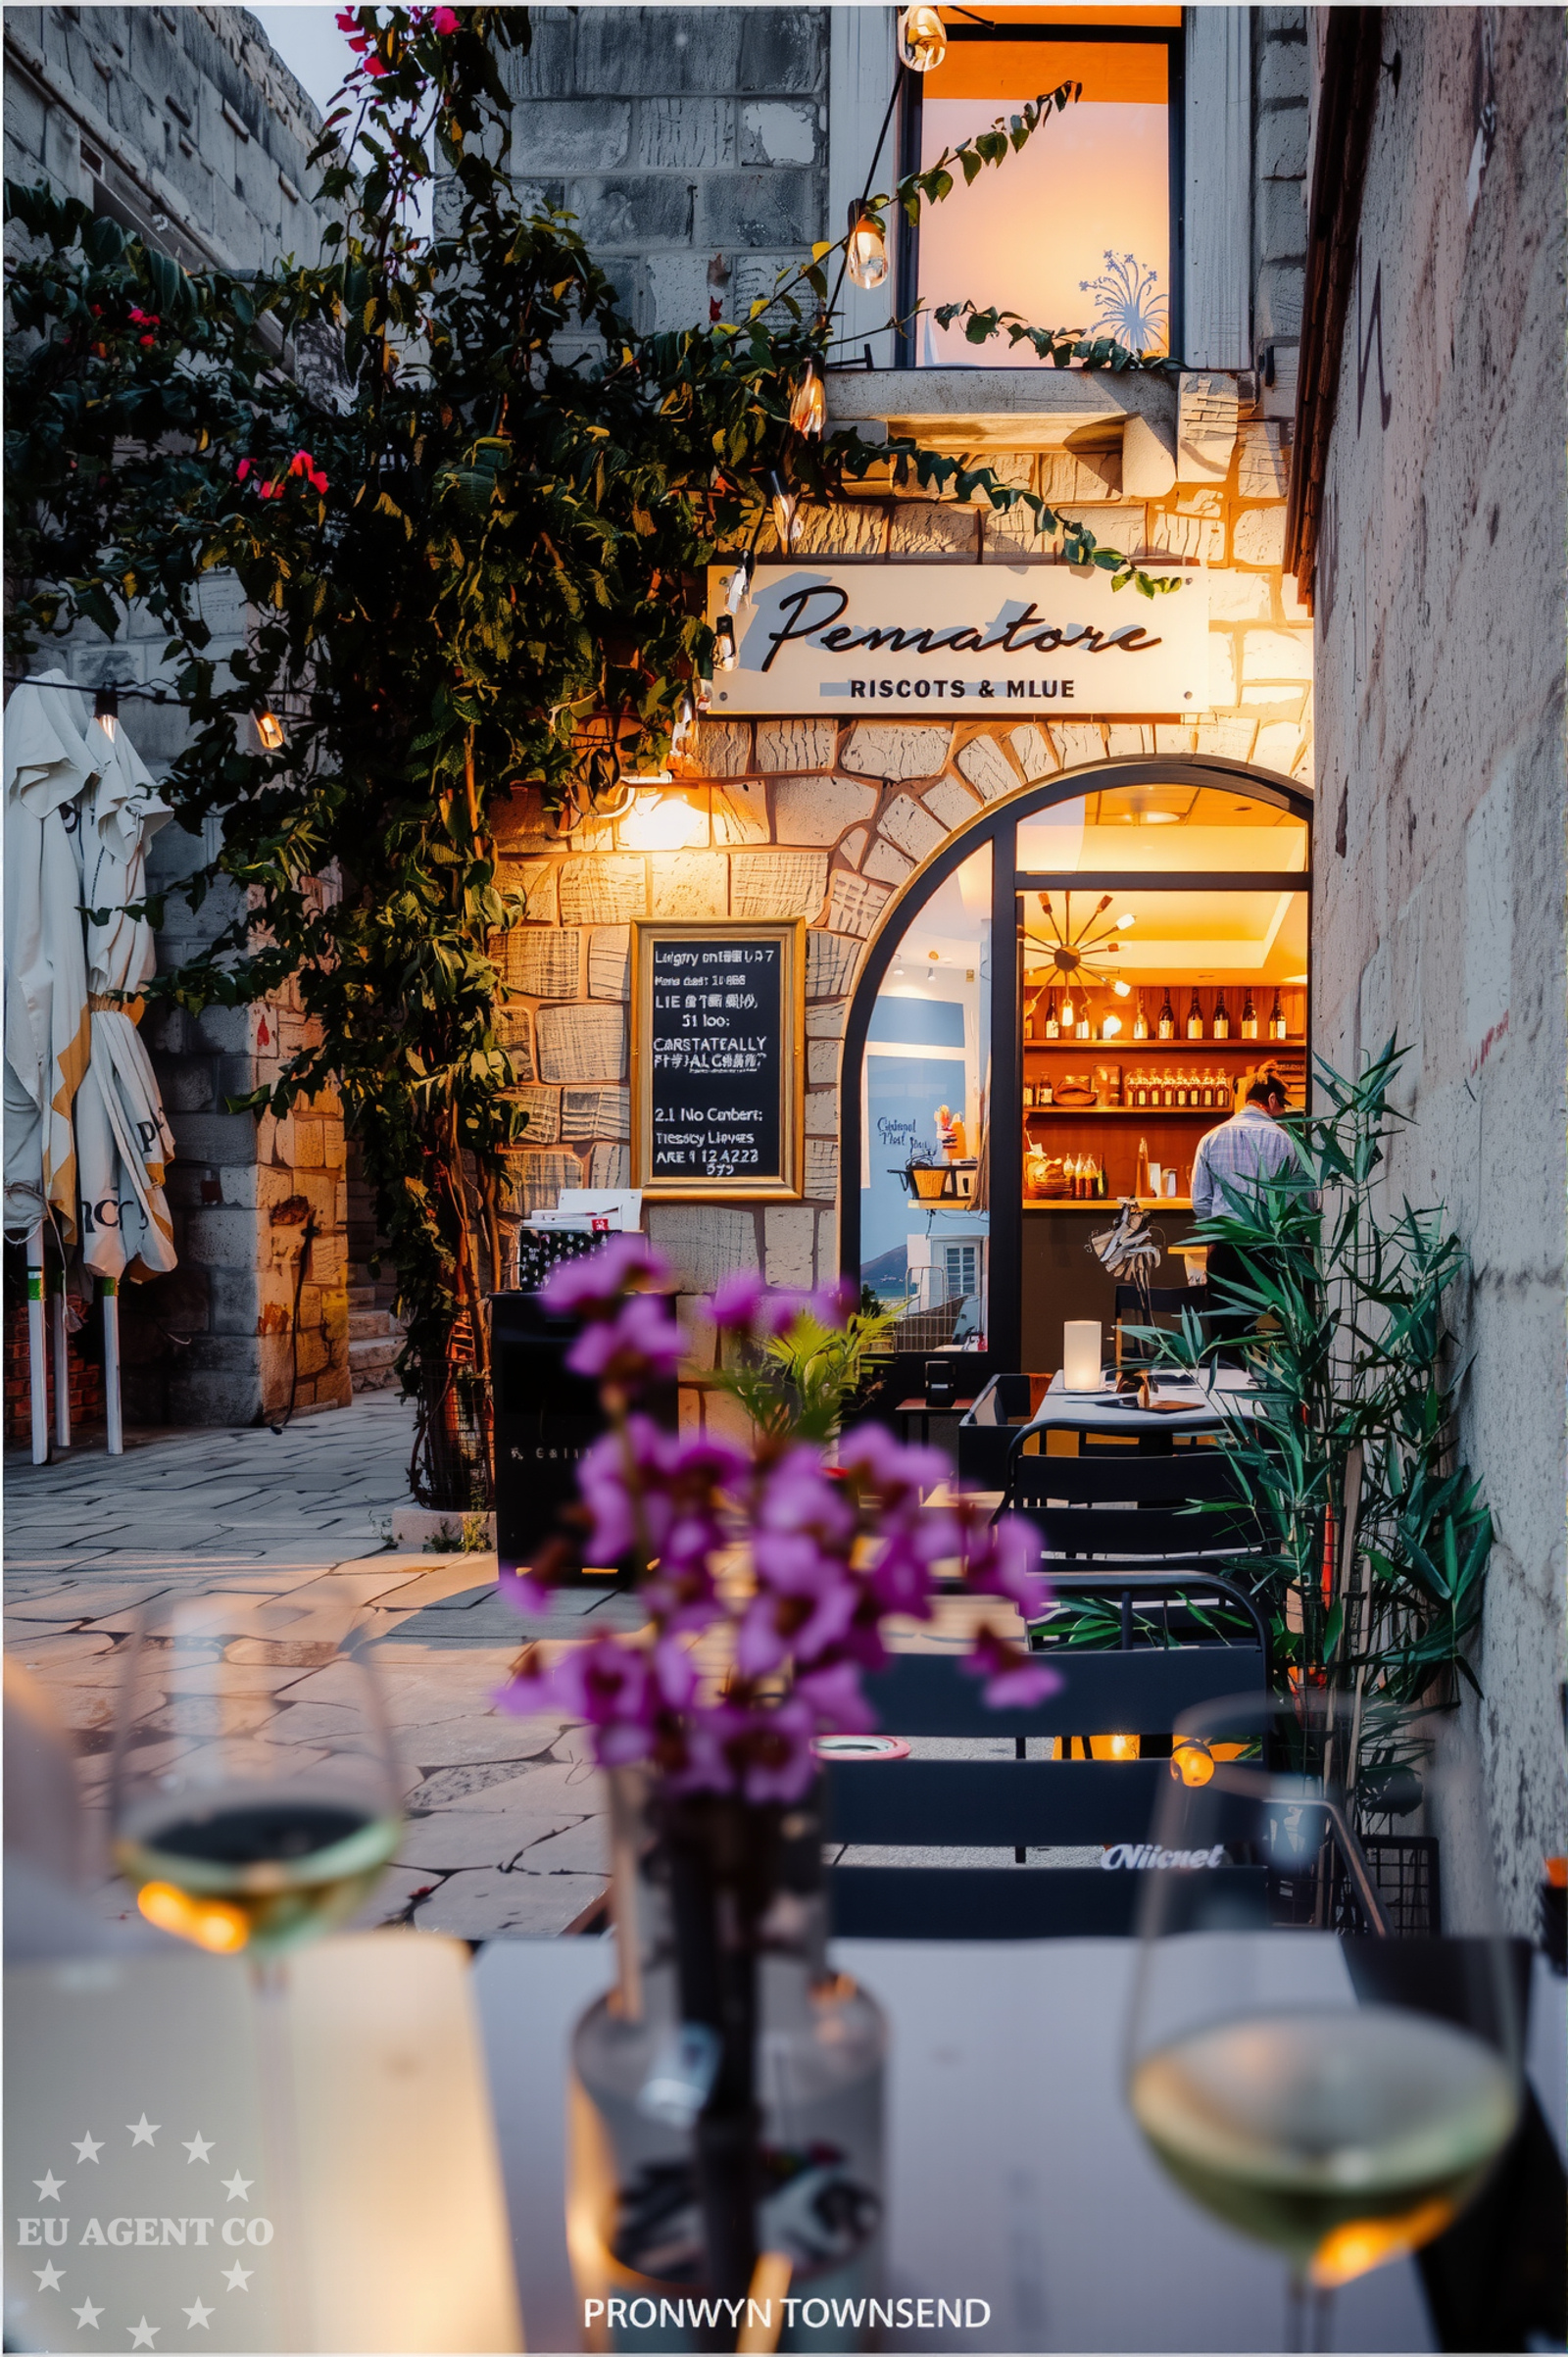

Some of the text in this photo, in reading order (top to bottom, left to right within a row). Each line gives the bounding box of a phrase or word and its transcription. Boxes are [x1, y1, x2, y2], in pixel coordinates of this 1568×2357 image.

[850, 678, 1076, 700] RISCOTS & MLUE
[680, 1107, 705, 1122] No
